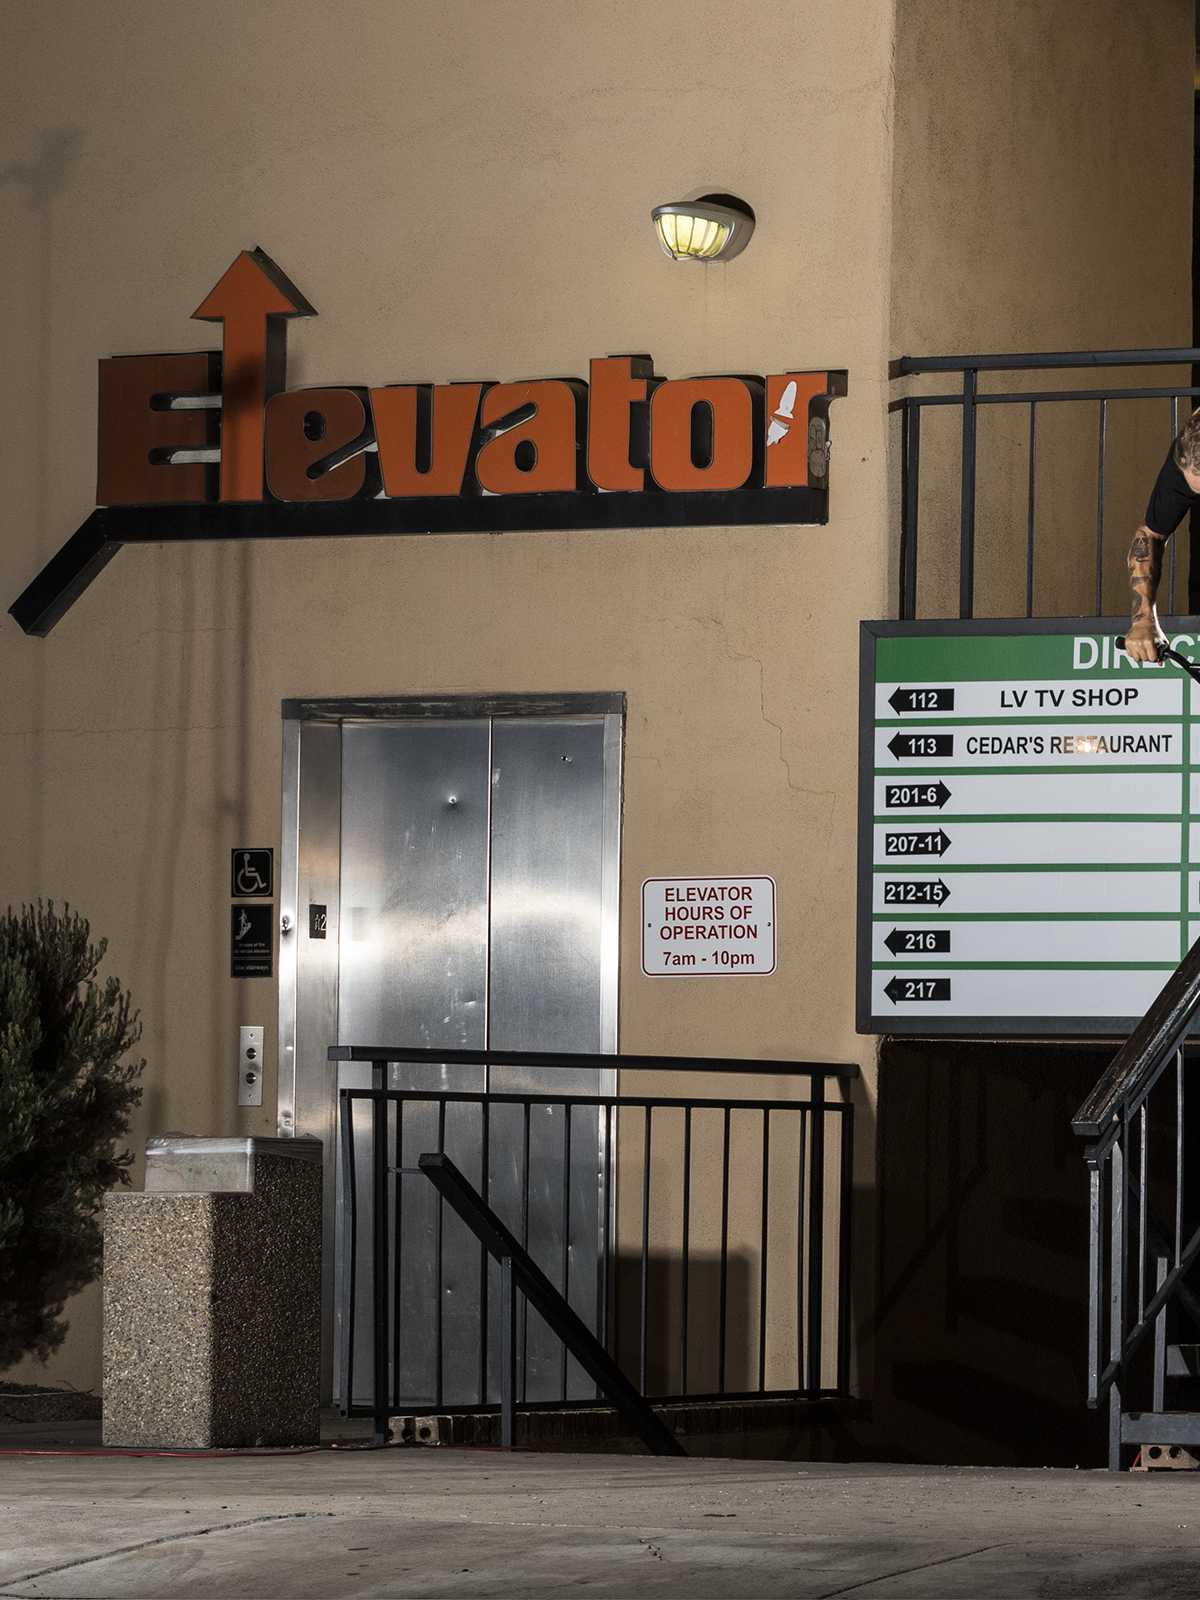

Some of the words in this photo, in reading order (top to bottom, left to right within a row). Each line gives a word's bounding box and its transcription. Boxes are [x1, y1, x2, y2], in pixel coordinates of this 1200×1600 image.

[96, 248, 842, 506] Elevator
[909, 692, 938, 709] 112
[1000, 690, 1028, 708] LV
[1035, 689, 1065, 707] TV
[1072, 688, 1139, 707] SHOP
[908, 738, 937, 754] 113
[966, 736, 1045, 755] CEDAR'S
[1050, 735, 1173, 754] RESTAURANT
[890, 787, 937, 804] 201-6
[887, 835, 942, 852] 207-11
[665, 886, 753, 902] ELEVATOR
[886, 885, 943, 901] 212-15
[665, 906, 724, 921] HOURS
[729, 905, 753, 920] OF
[660, 924, 758, 941] OPERATION
[905, 933, 936, 950] 216
[662, 951, 696, 966] 7am
[711, 950, 755, 968] 10pm
[905, 982, 936, 999] 217
